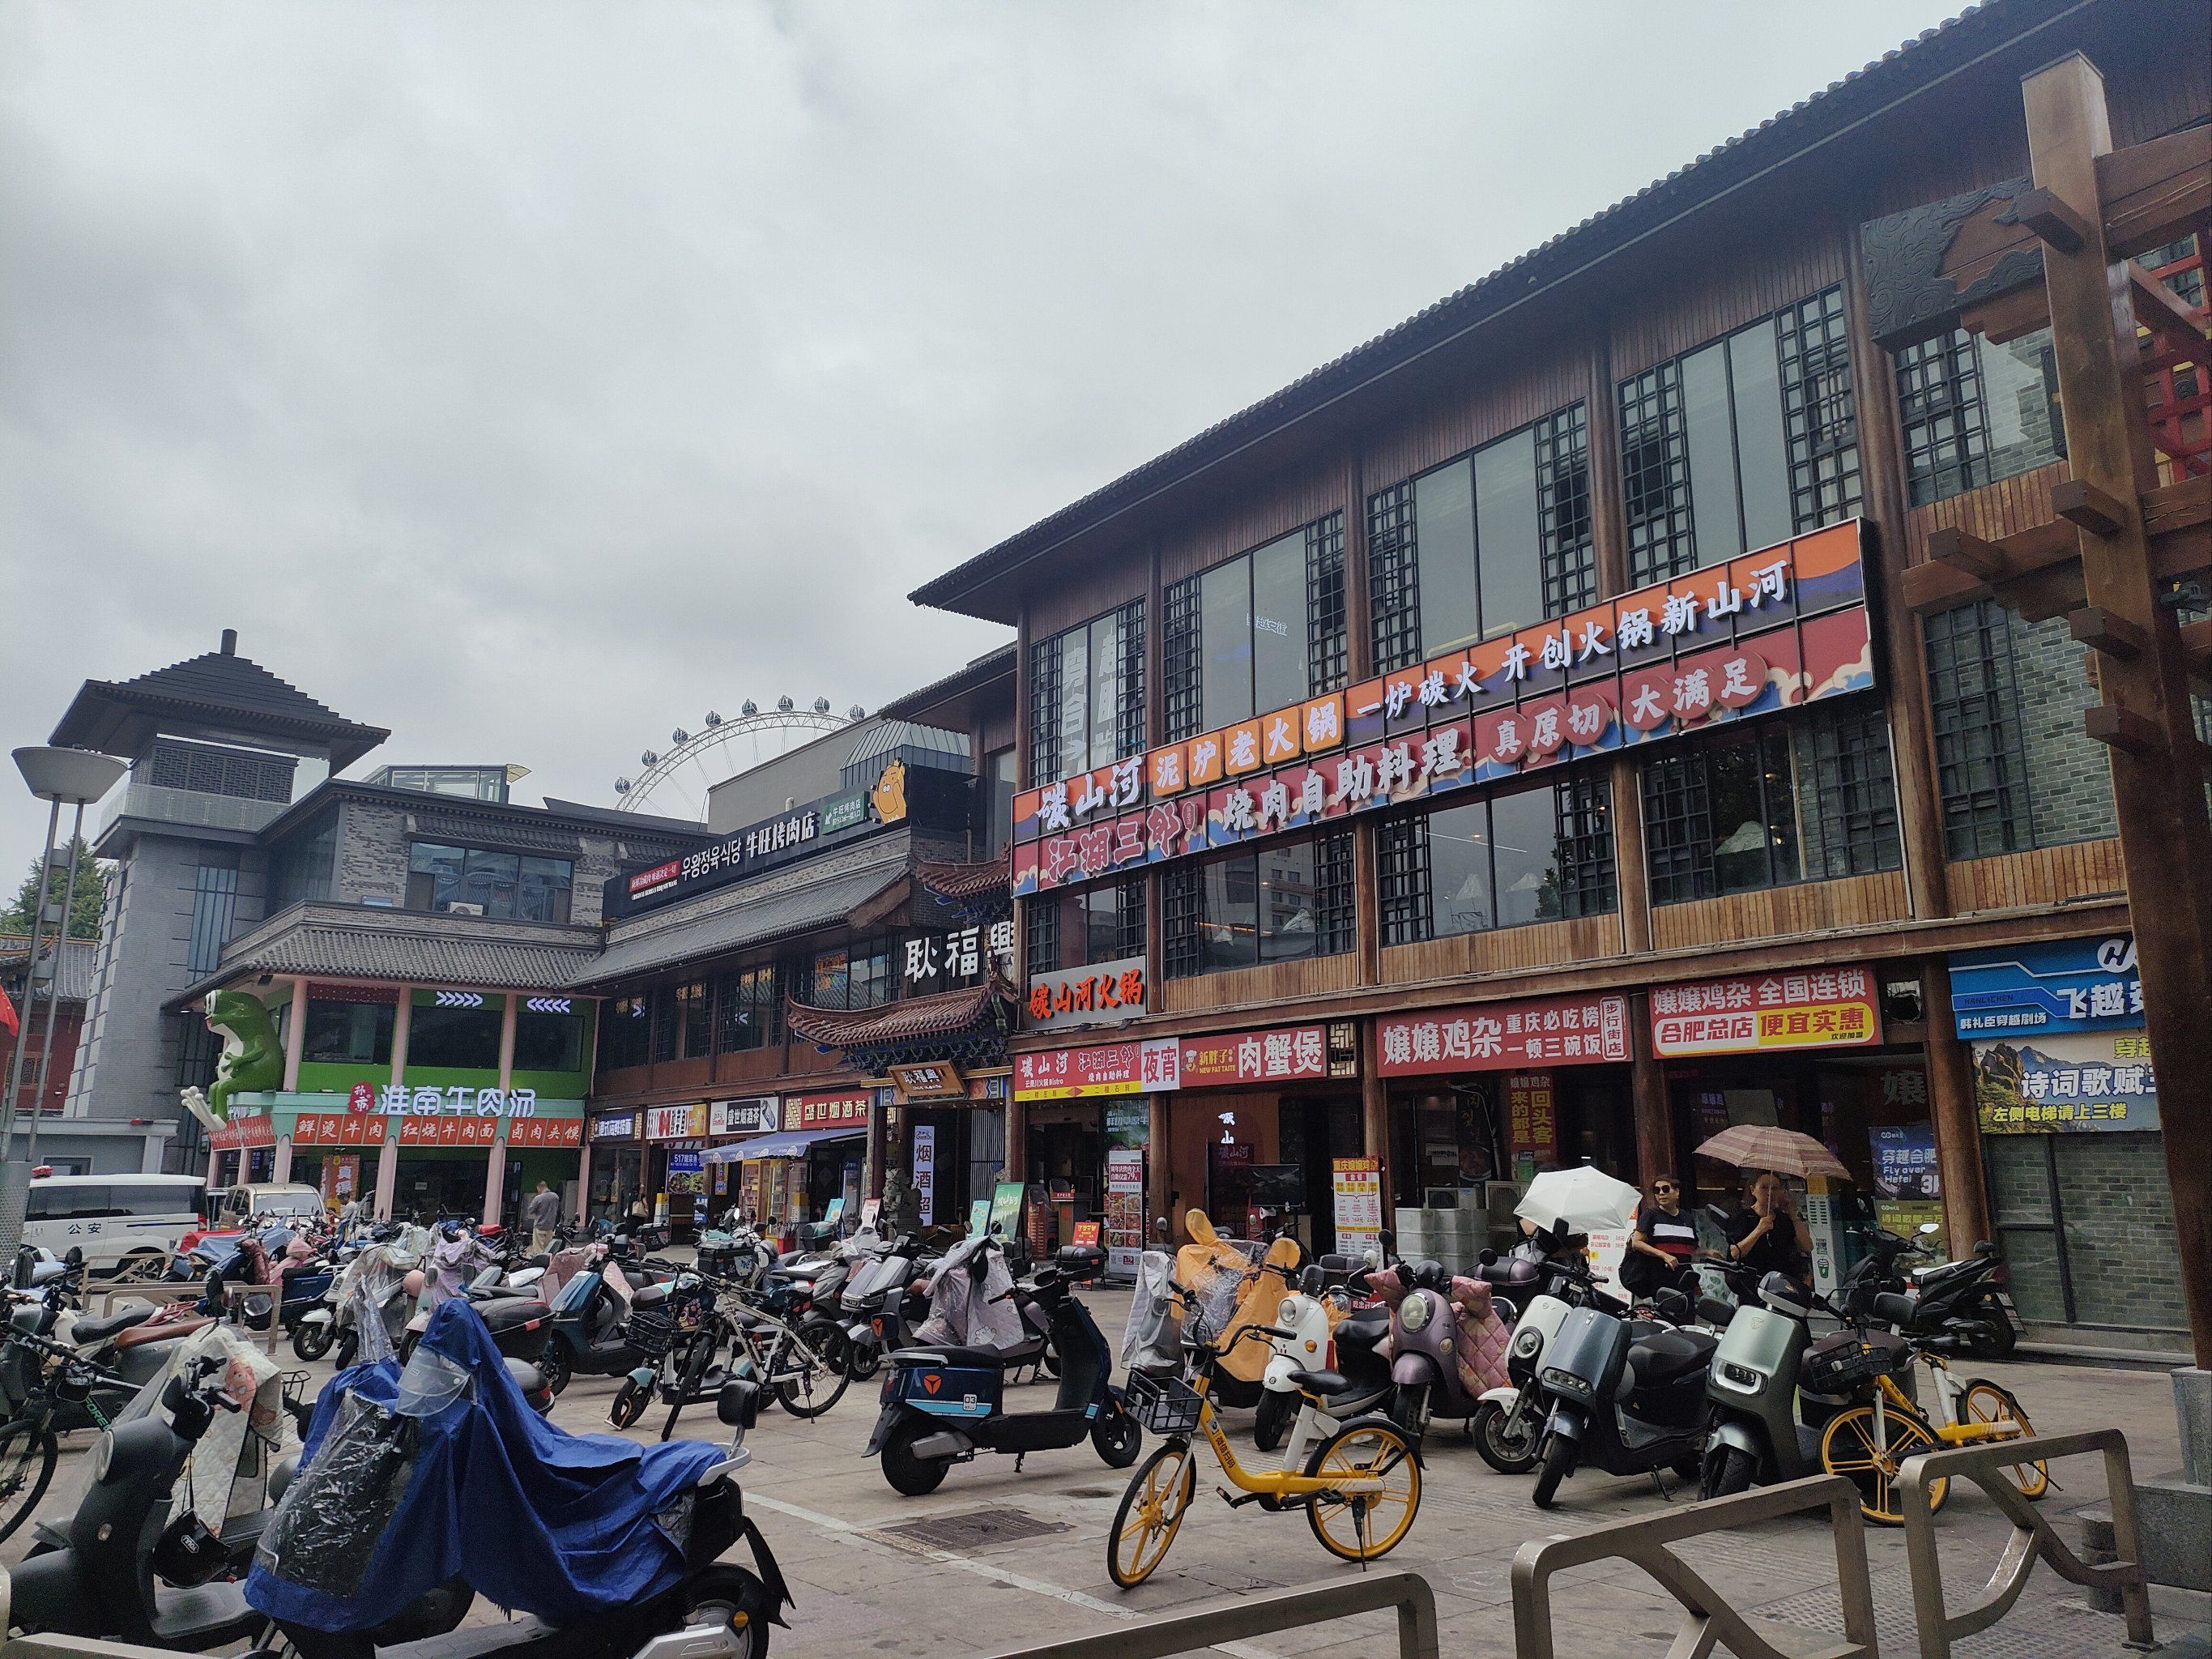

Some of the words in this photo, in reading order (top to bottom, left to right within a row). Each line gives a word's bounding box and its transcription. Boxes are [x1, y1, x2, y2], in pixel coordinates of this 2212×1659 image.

[1037, 756, 1143, 830] 碳山河
[1156, 701, 1338, 788] 泥炉老火锅
[1357, 661, 1482, 719] 一炉碳火
[1502, 559, 1788, 683] 开创火锅新山河
[1221, 727, 1462, 833] 烧肉自助料理
[1496, 702, 1600, 757] 真原切
[1631, 657, 1758, 723] 大满足
[744, 810, 816, 859] 牛旺烤肉店
[680, 839, 743, 883] 우왕정육식당
[1028, 968, 1144, 1020] 碳山河火锅
[1653, 981, 1752, 1016] 嬢嬢鸡杂
[1757, 969, 1867, 1006] 全国连锁
[1506, 1006, 1600, 1034] 重庆必吃榜
[1605, 1002, 1622, 1055] 步行街店
[1660, 1015, 1754, 1044] 合肥总店
[1760, 1007, 1865, 1038] 便宜实惠
[1959, 1012, 2048, 1030] 韩礼臣穿越剧场
[1383, 1016, 1502, 1066] 嬢嬢鸡杂
[1507, 1033, 1602, 1060] 一顿三碗饭
[1831, 1030, 1864, 1041] 欢迎加盟
[1143, 1045, 1177, 1084] 夜宵
[1199, 1049, 1228, 1067] 新胖子
[1238, 1030, 1323, 1078] 肉蟹煲
[1048, 1077, 1063, 1085] Bistro
[1088, 1069, 1130, 1082] 烧肉自助料理
[1199, 1066, 1212, 1074] NEW
[1212, 1065, 1222, 1073] FAT
[1221, 1064, 1236, 1073] TASTE
[379, 1084, 536, 1118] 淮南牛肉汤
[803, 1099, 867, 1121] 盛世烟酒茶
[1993, 1102, 2128, 1123] 左侧电梯请上三楼
[296, 1119, 384, 1139] 鲜烫牛肉
[727, 1107, 761, 1126] 盛世烟酒茶
[1531, 1090, 1554, 1145] 回头客
[402, 1124, 495, 1140] 红烧牛肉面
[510, 1124, 581, 1141] 卤肉夹馍
[1883, 1166, 1899, 1175] Fly
[68, 1222, 102, 1235] 公安
[964, 1396, 977, 1405] 03
[1215, 1435, 1236, 1469] 微信扫码
